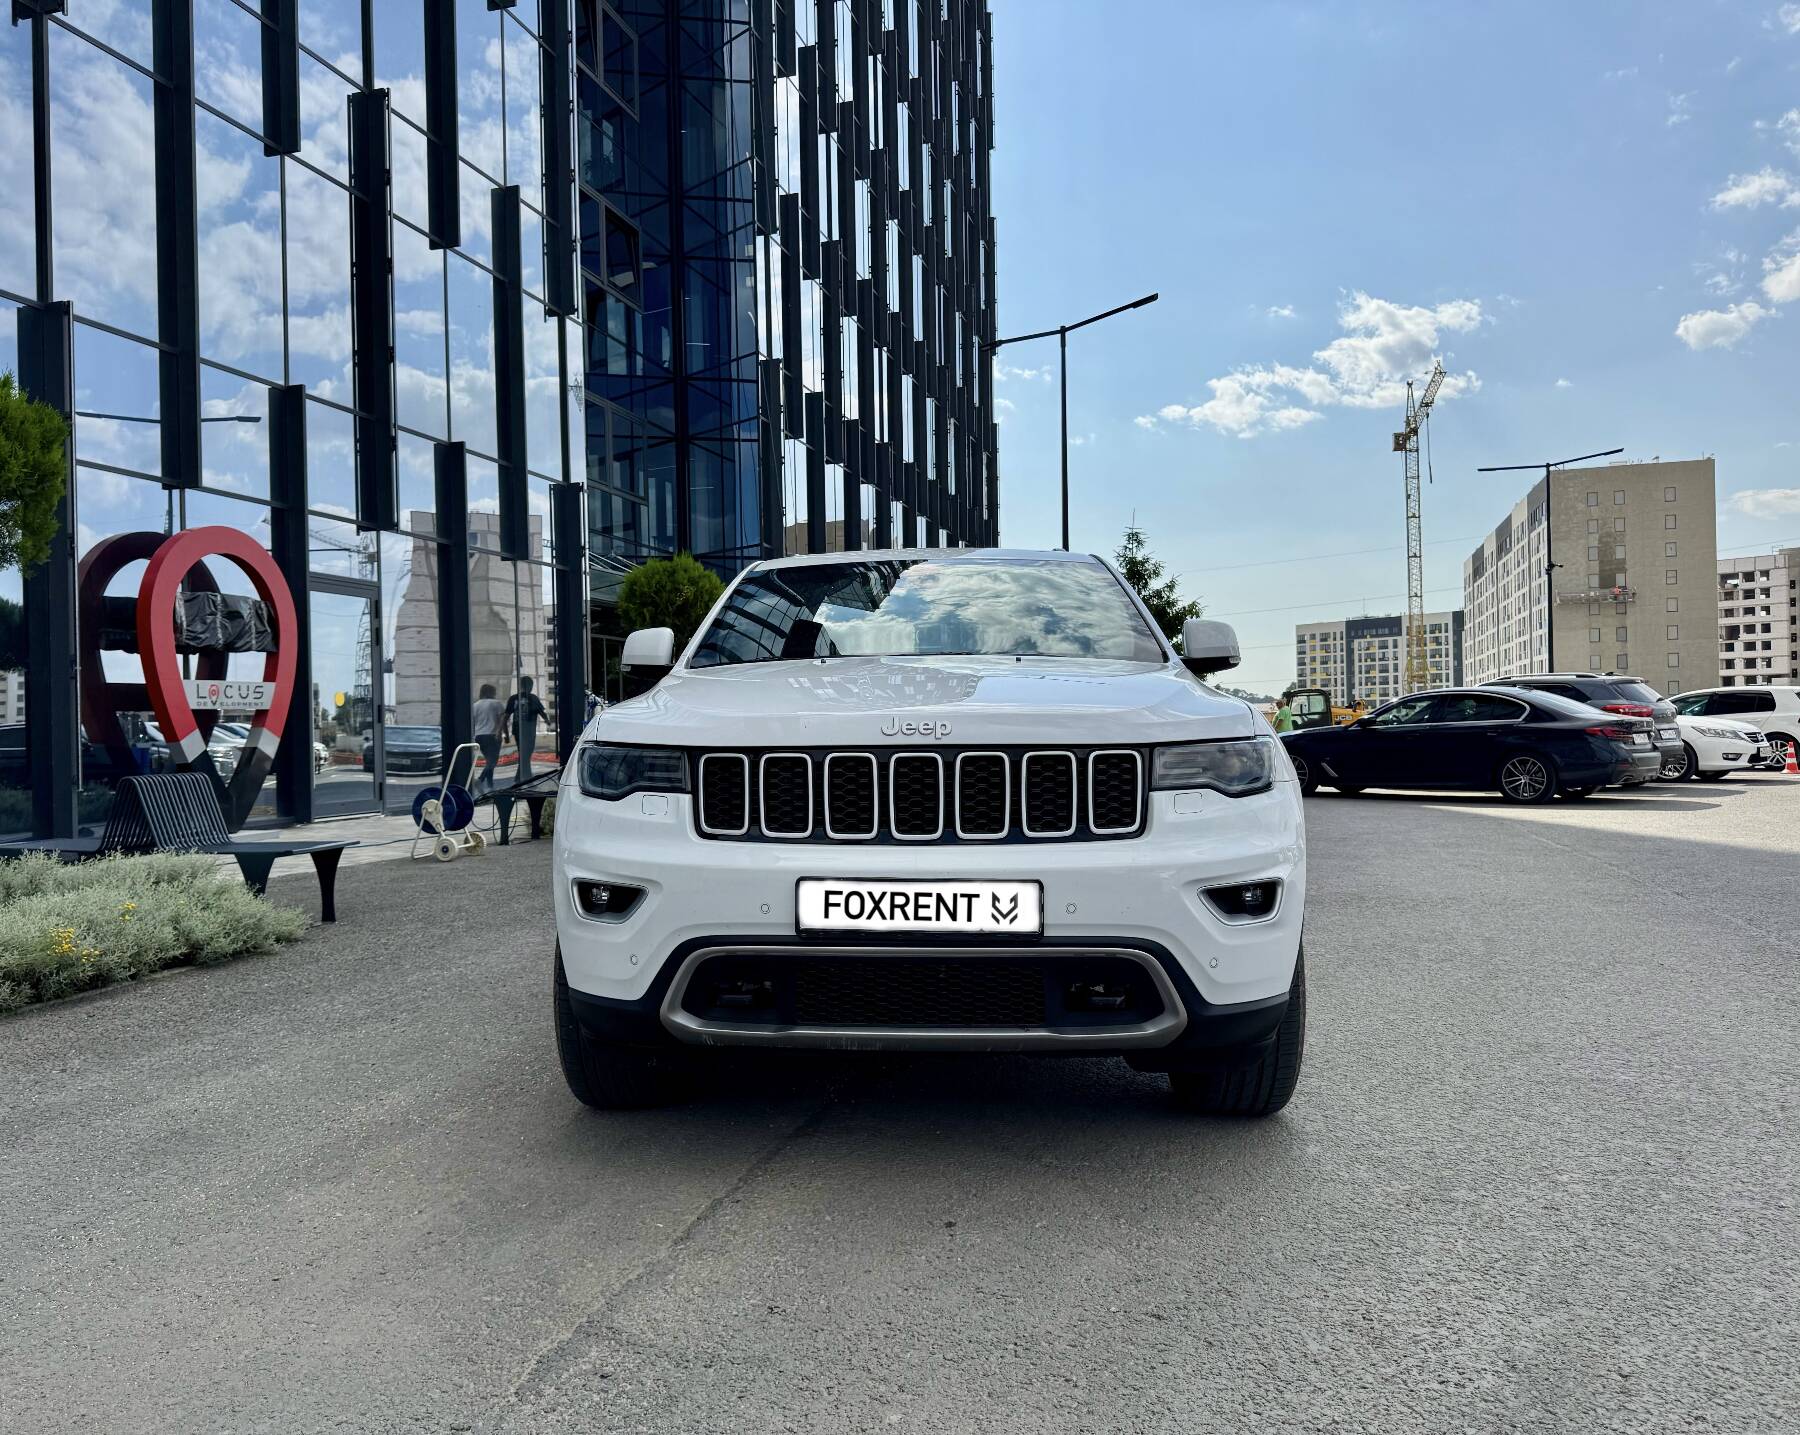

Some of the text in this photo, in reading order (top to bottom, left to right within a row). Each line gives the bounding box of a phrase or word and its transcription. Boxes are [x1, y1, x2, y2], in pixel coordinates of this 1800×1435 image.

[196, 683, 264, 700] LOCUS
[881, 716, 952, 740] Jeep
[824, 890, 980, 922] FOXRENT
